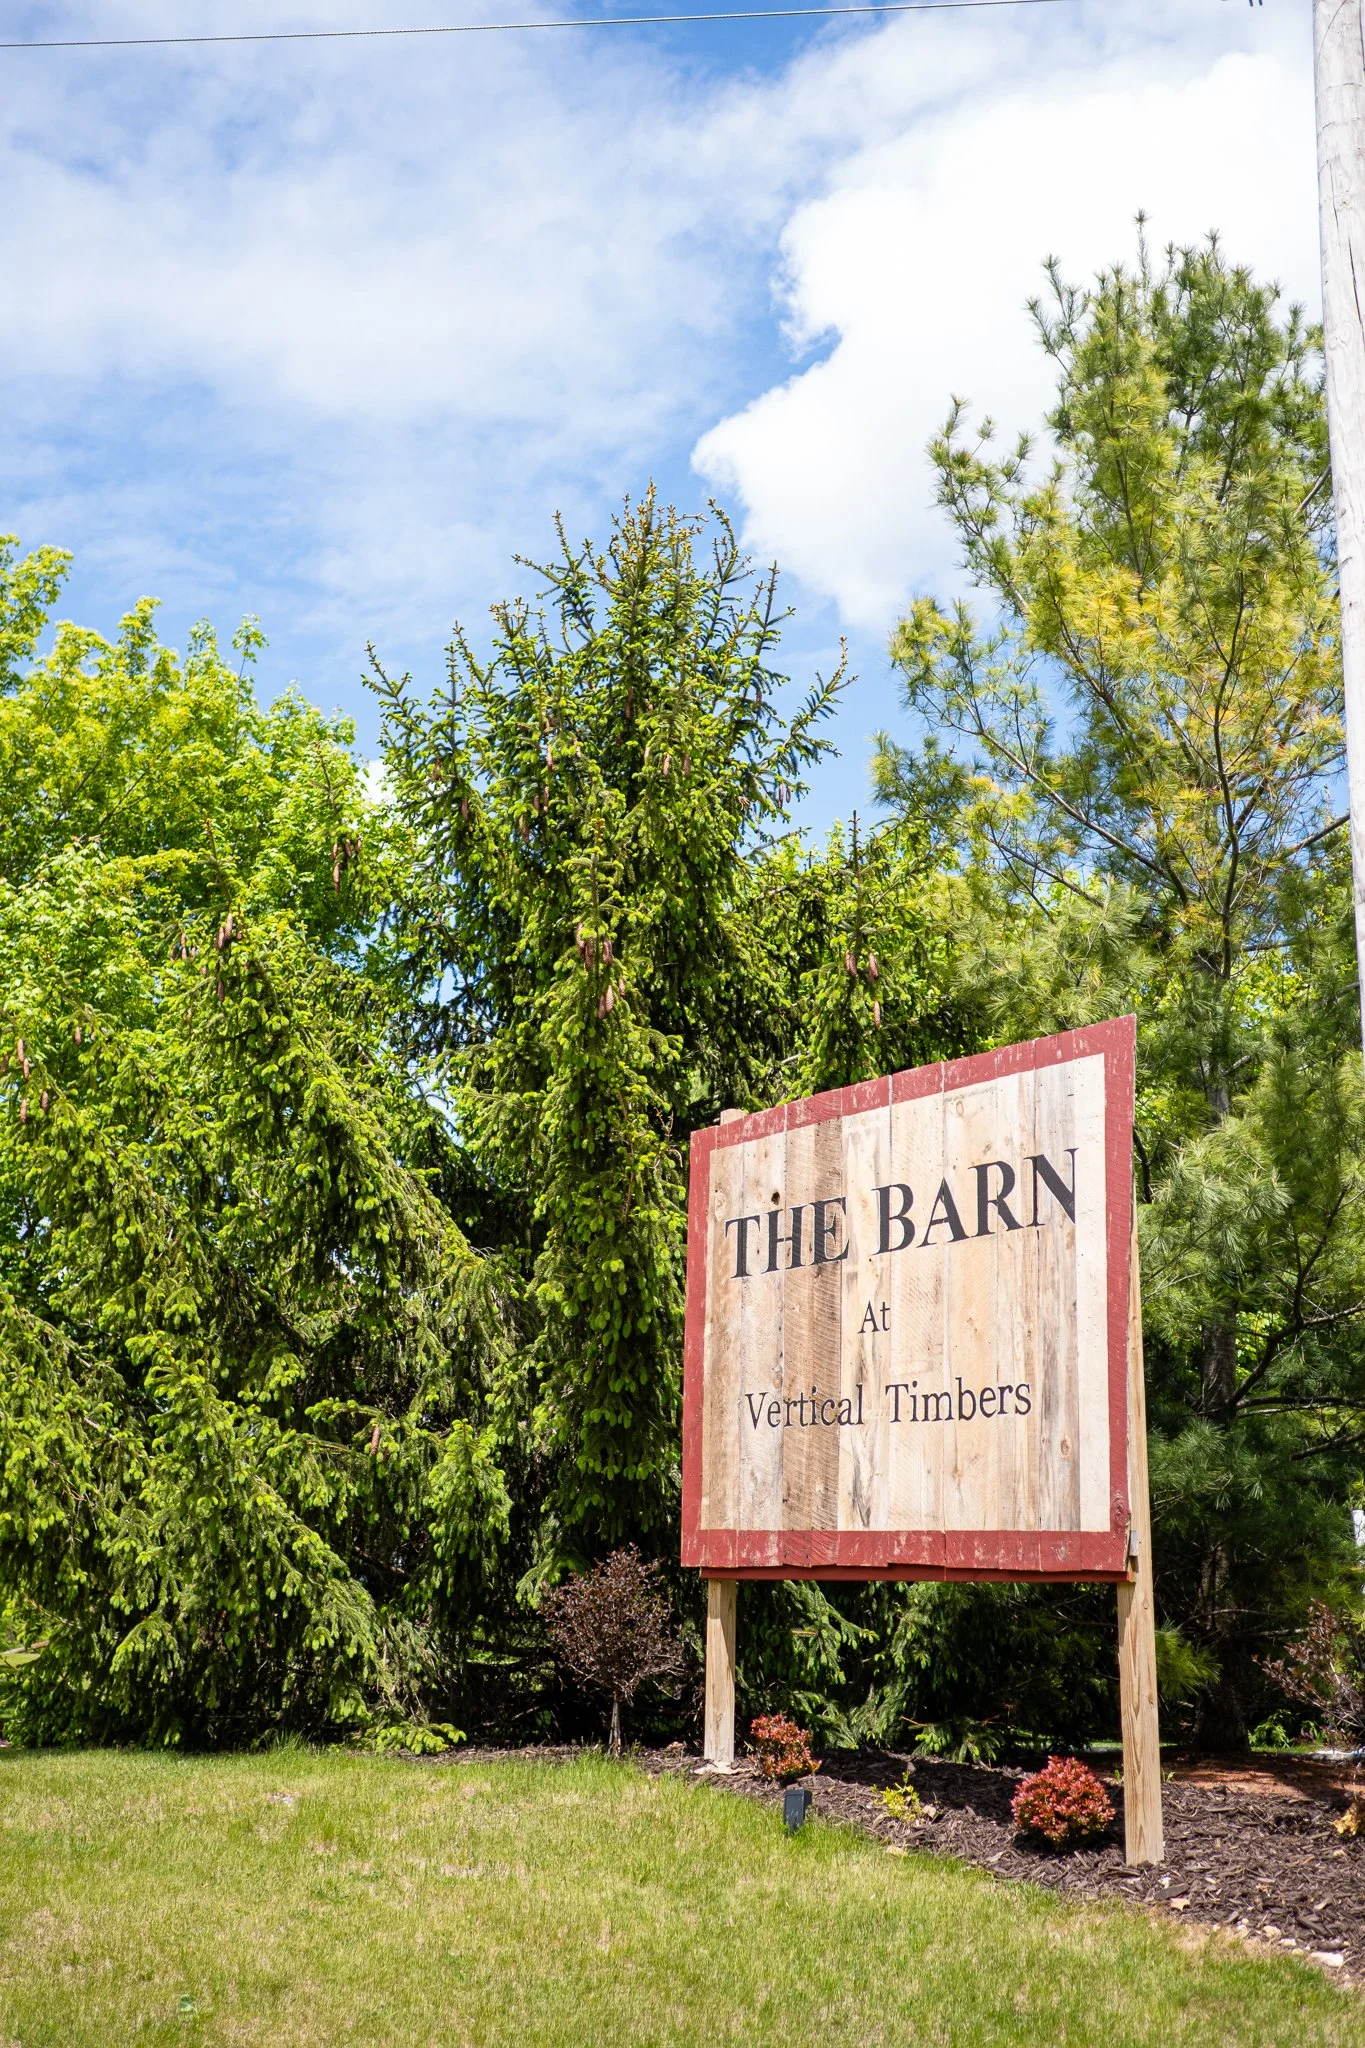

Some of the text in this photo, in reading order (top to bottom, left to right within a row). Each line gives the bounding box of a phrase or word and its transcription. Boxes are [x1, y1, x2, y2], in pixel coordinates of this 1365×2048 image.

[725, 1148, 1080, 1280] THE BARN
[858, 1301, 891, 1334] At
[745, 1377, 1033, 1430] Vertical Timbers
